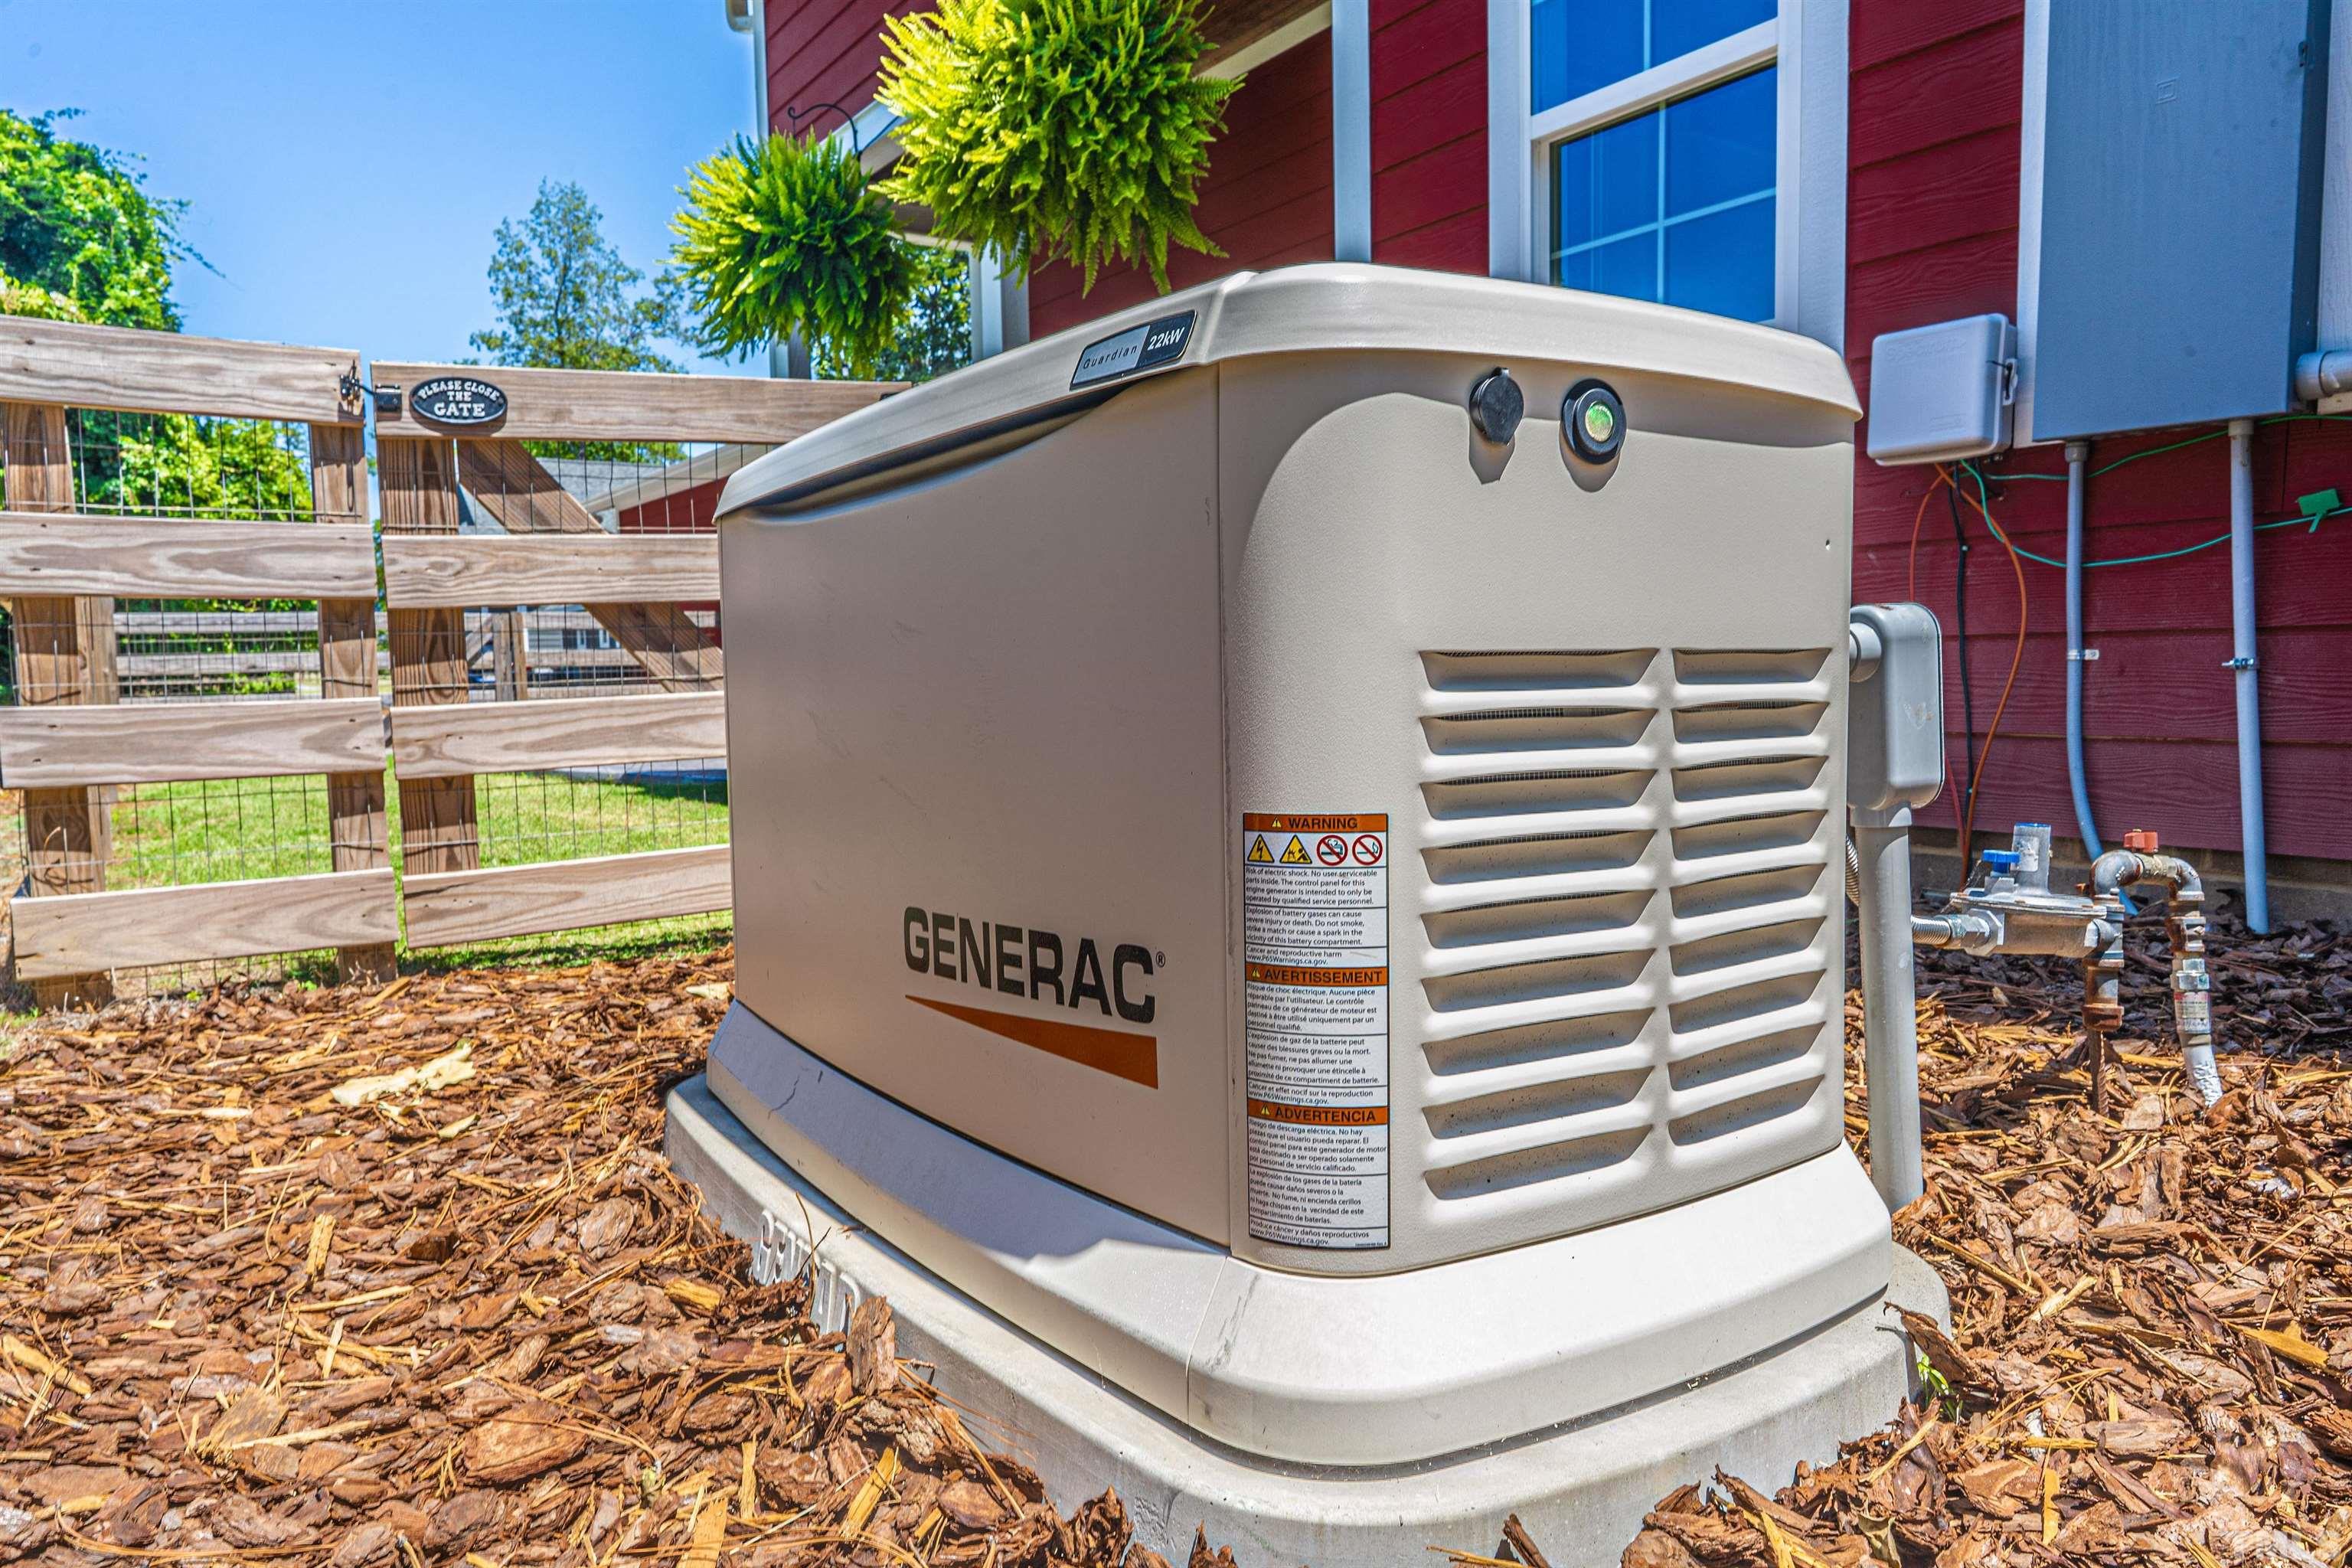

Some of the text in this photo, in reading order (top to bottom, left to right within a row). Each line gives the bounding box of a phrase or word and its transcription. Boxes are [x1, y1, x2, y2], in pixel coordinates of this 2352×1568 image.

[1083, 327, 1185, 369] Guardian 22kW
[418, 380, 501, 400] PLEASE CLOSE
[447, 391, 472, 401] THE
[434, 403, 485, 417] GATE
[1289, 817, 1358, 829] WARNING
[1282, 910, 1306, 918] battery
[1287, 936, 1311, 945] battery
[1265, 969, 1383, 983] AVERTISSEMENT
[1279, 1044, 1308, 1053] blessures
[1282, 1065, 1315, 1073] provoquer
[1276, 1106, 1376, 1122] ADVERTENCIA
[1276, 1124, 1305, 1134] descarga
[1261, 1148, 1291, 1158] destinado
[1269, 1201, 1290, 1211] chispas
